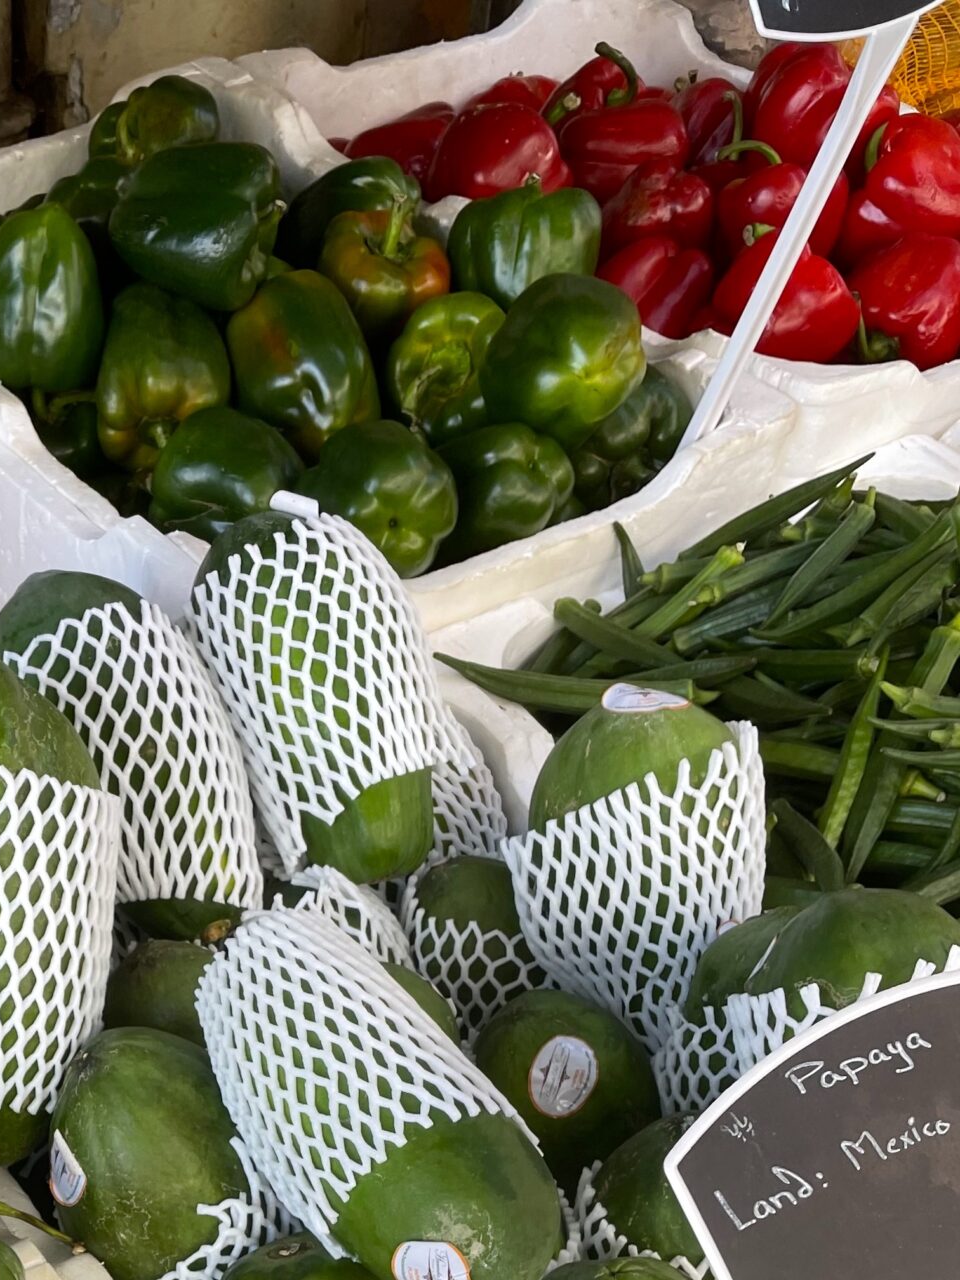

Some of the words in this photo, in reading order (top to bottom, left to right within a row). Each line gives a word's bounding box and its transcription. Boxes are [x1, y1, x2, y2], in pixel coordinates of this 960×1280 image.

[784, 1031, 933, 1094] Papaya
[714, 1165, 830, 1231] Land:
[840, 1116, 951, 1171] Mexico
